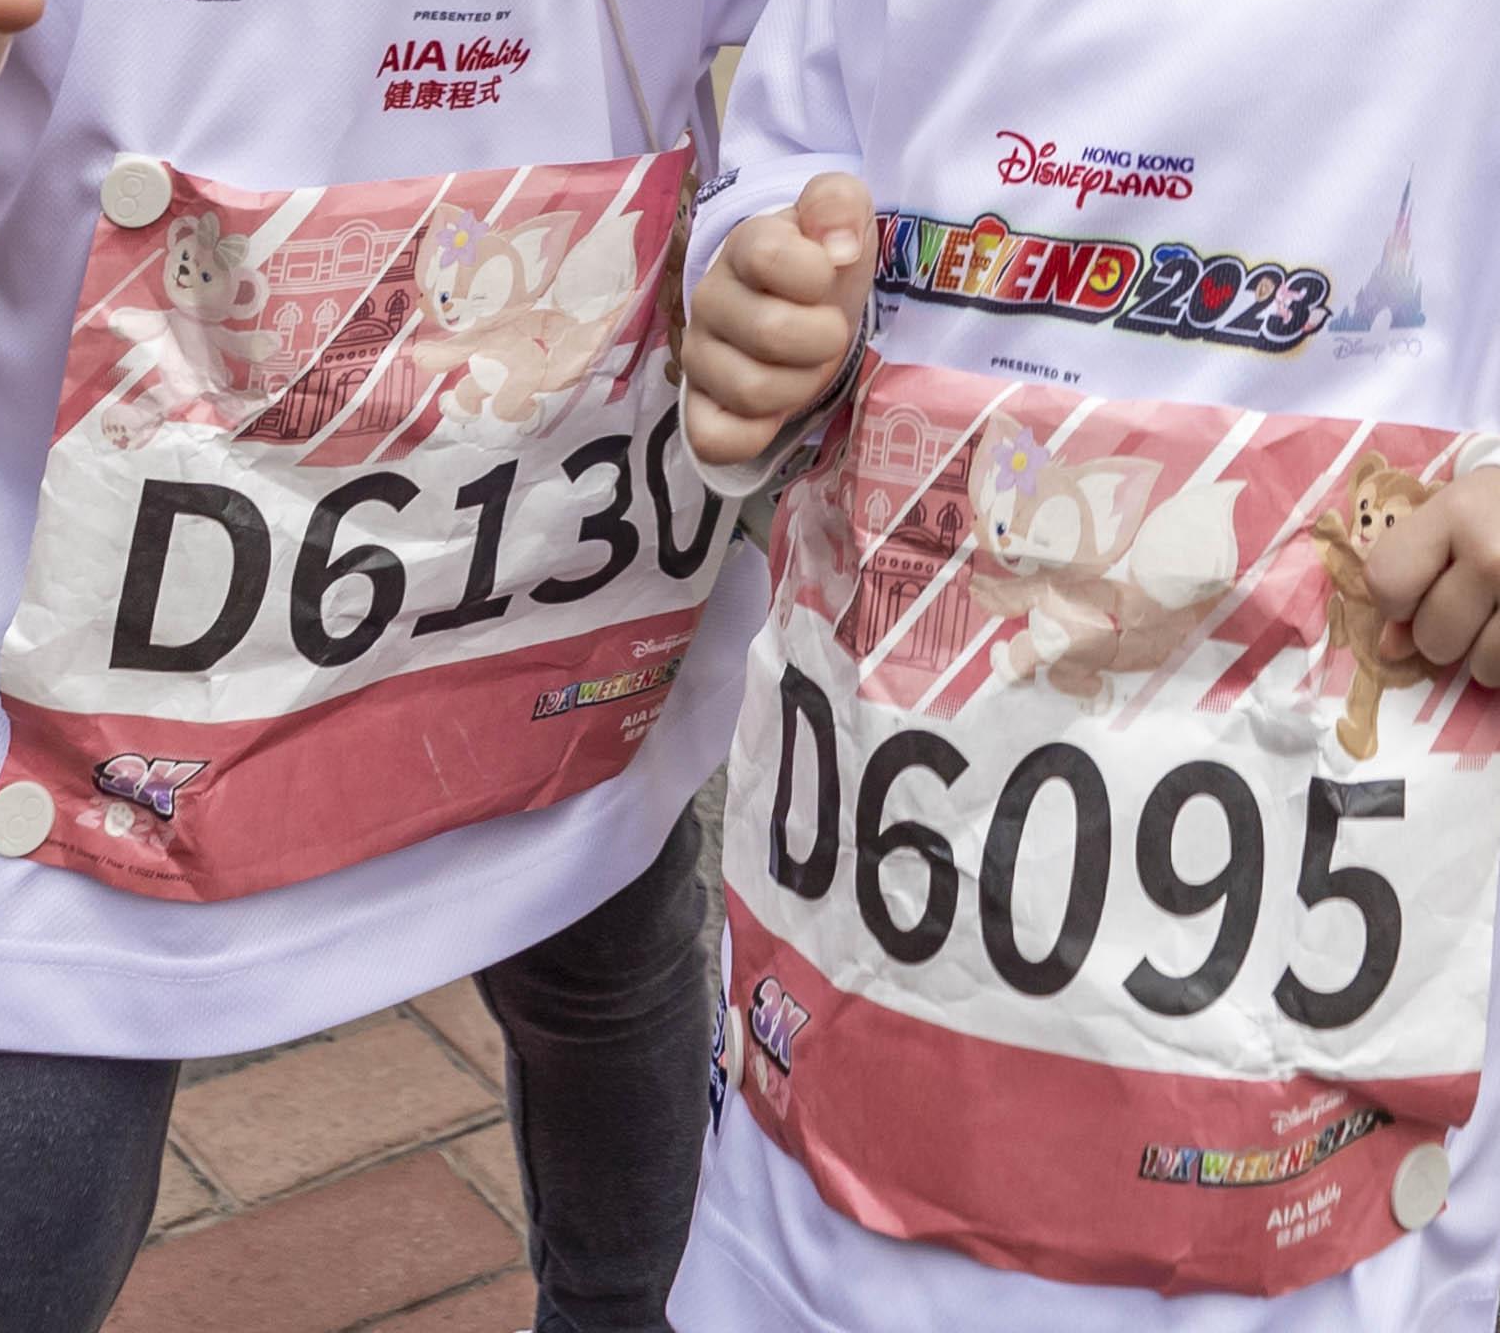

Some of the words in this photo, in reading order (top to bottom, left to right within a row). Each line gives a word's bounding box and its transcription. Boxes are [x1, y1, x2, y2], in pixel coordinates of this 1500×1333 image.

[413, 10, 492, 23] PRESENTED
[495, 10, 512, 21] BY
[376, 39, 447, 79] AIA
[455, 35, 531, 75] Vitality
[383, 74, 503, 112] 健康程式
[1080, 146, 1132, 169] HONG
[1136, 153, 1195, 174] KONG
[910, 214, 1142, 313] WEEKEND
[1128, 244, 1332, 342] 2023
[990, 356, 1059, 379] PRESENTED
[1063, 371, 1082, 384] BY
[109, 399, 724, 672] D6130
[768, 661, 1406, 1031] D6095
[1266, 1200, 1306, 1233] AIA
